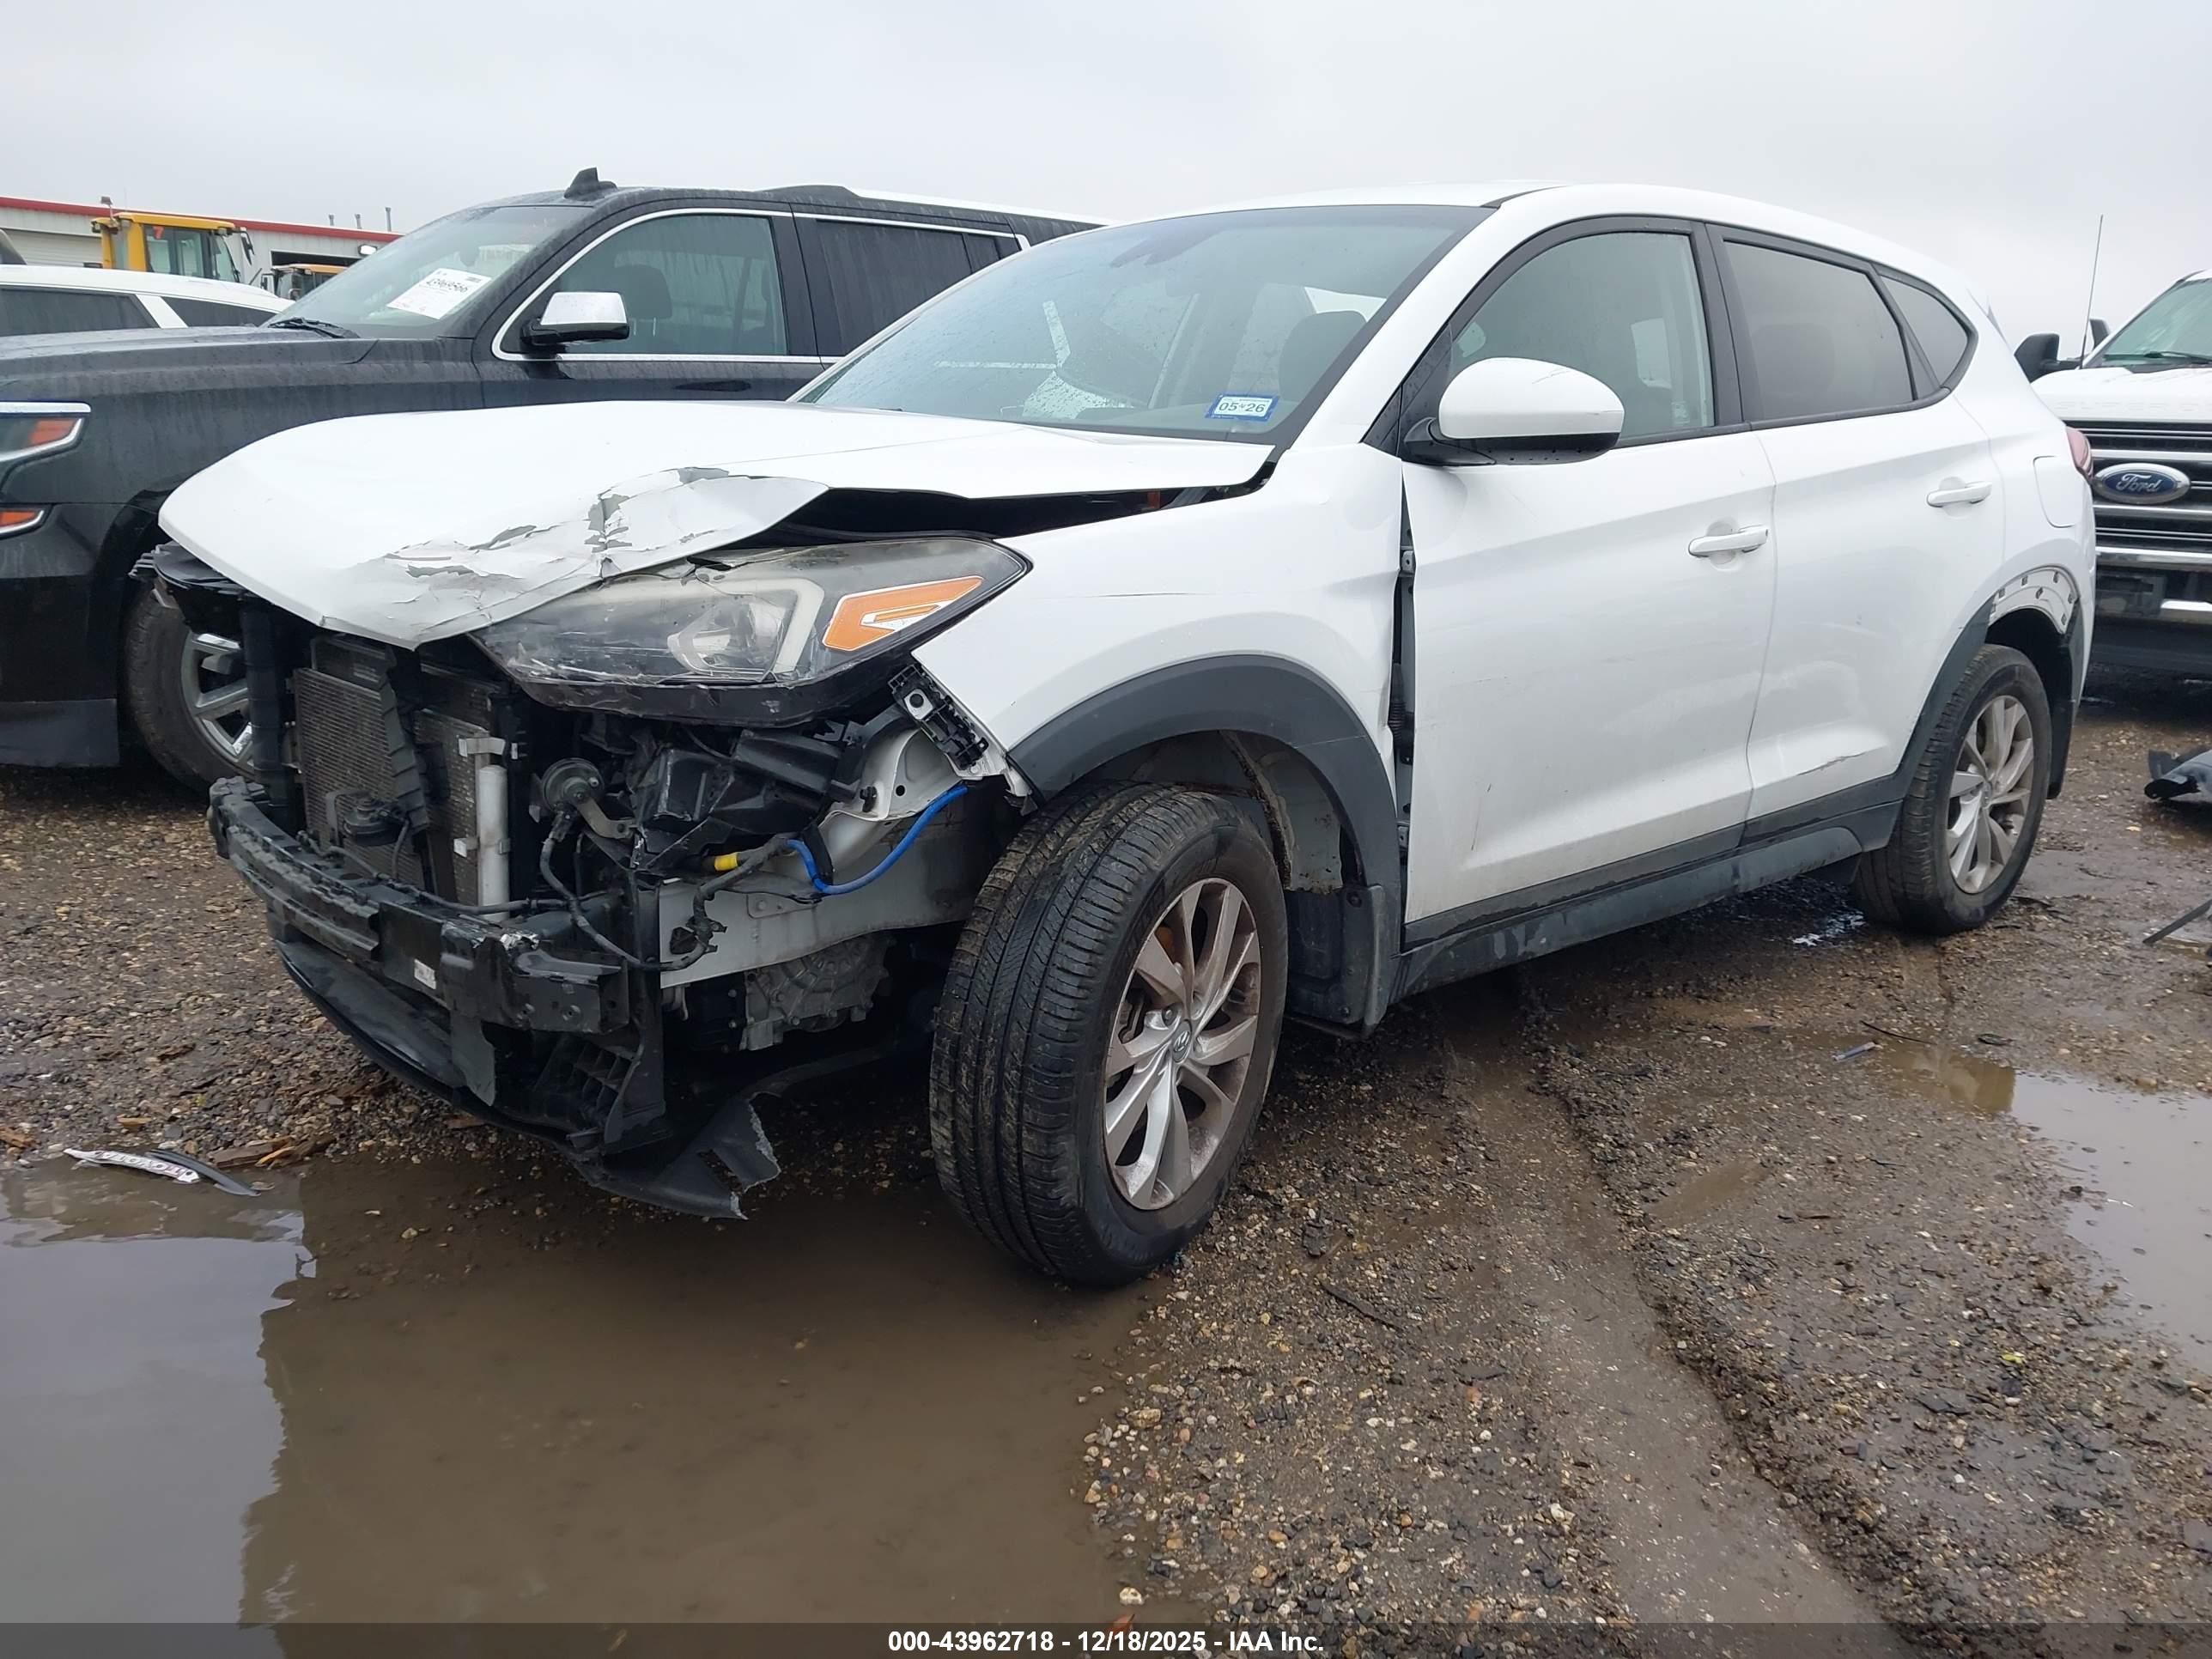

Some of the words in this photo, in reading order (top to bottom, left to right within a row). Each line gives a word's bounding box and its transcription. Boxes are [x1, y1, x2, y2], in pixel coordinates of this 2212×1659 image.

[1218, 402, 1239, 411] 05
[1245, 403, 1267, 413] 26
[2115, 472, 2164, 493] Ford
